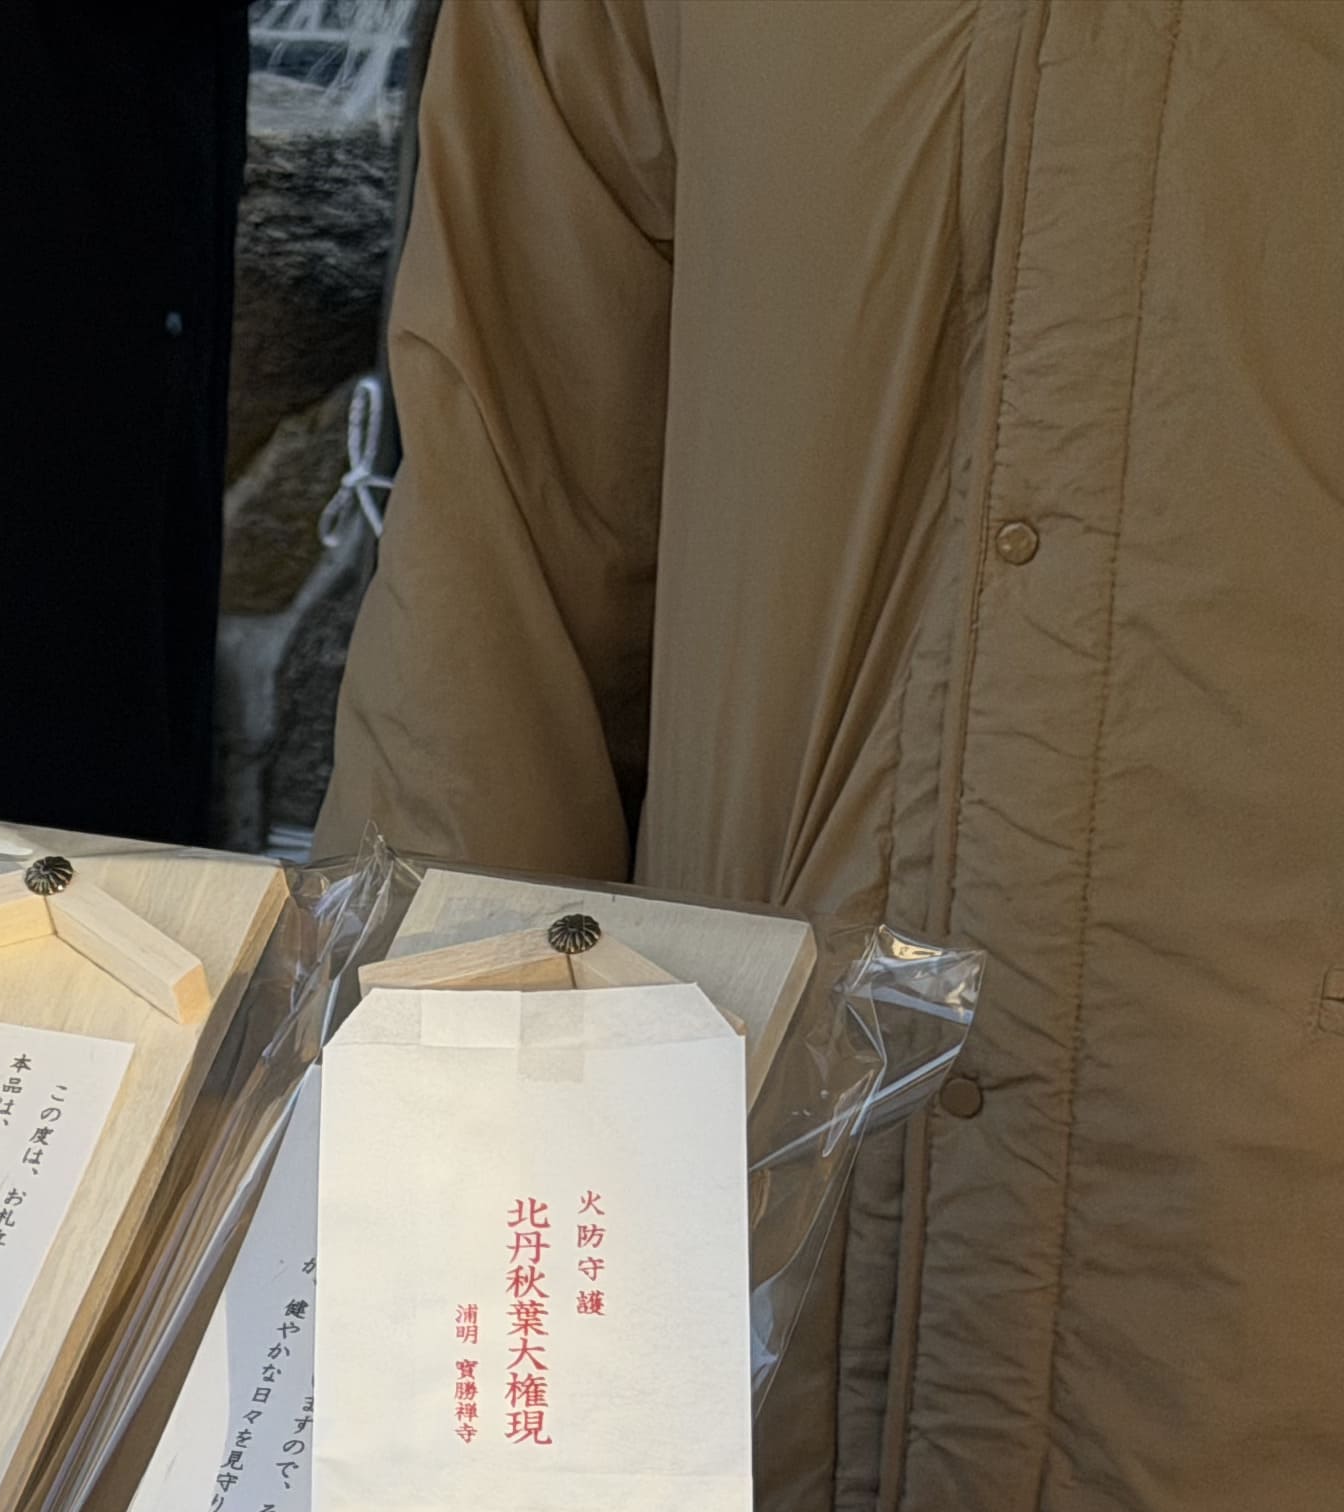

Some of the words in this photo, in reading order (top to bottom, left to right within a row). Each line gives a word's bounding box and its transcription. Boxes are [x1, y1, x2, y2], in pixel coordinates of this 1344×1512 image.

[575, 1190, 606, 1316] 火防守護
[455, 1304, 479, 1344] 浦明
[504, 1197, 553, 1445] 北丹秋葉大権現
